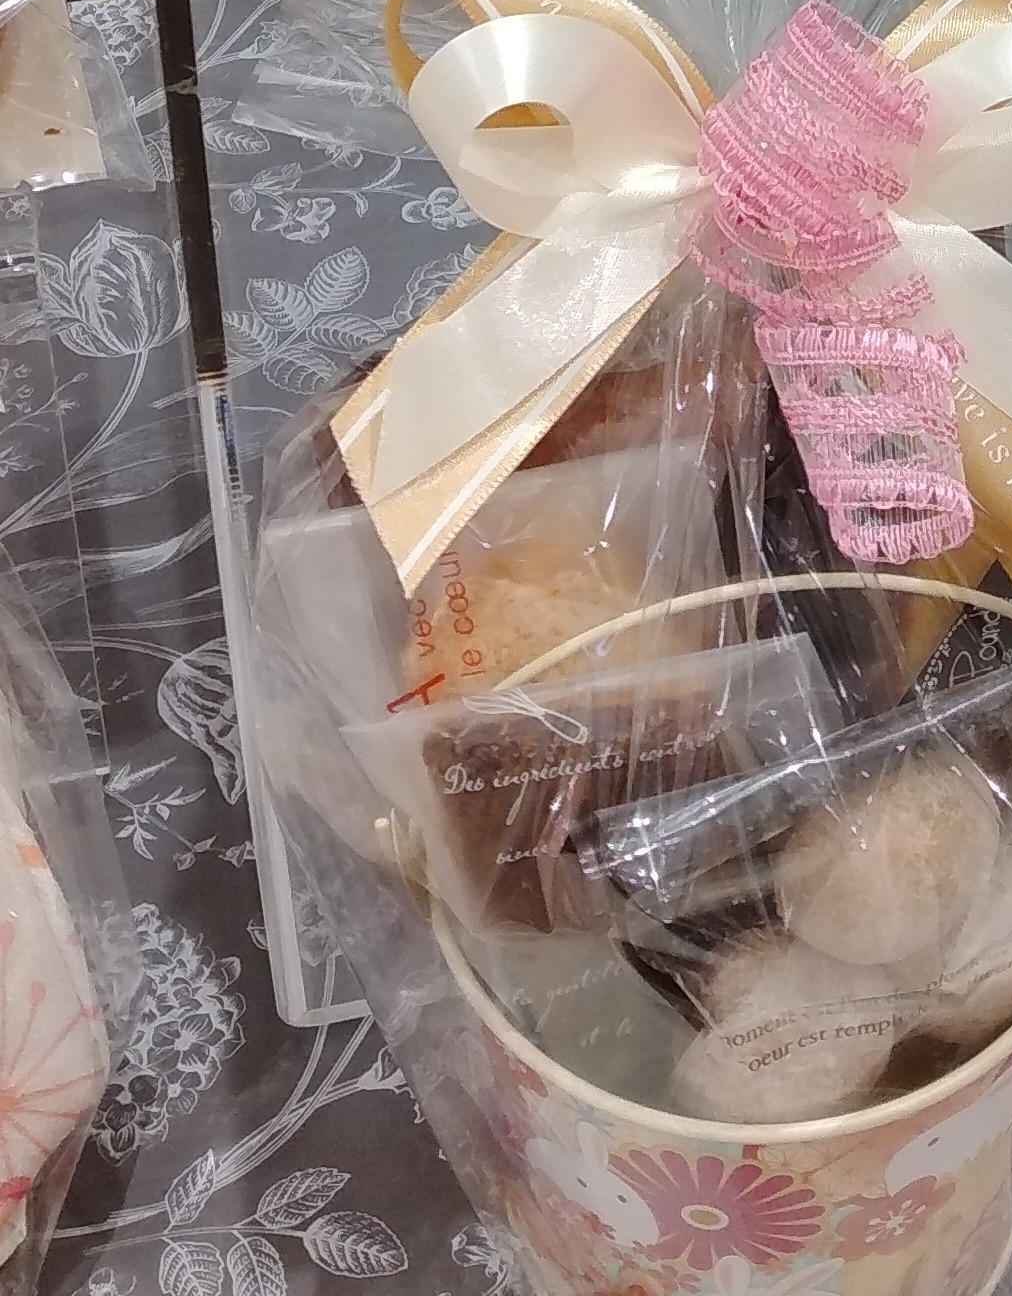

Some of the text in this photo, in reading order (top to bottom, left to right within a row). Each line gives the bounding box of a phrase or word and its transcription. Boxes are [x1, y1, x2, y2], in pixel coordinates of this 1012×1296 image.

[979, 425, 1011, 466] is
[459, 648, 488, 679] le
[797, 1027, 829, 1049] est
